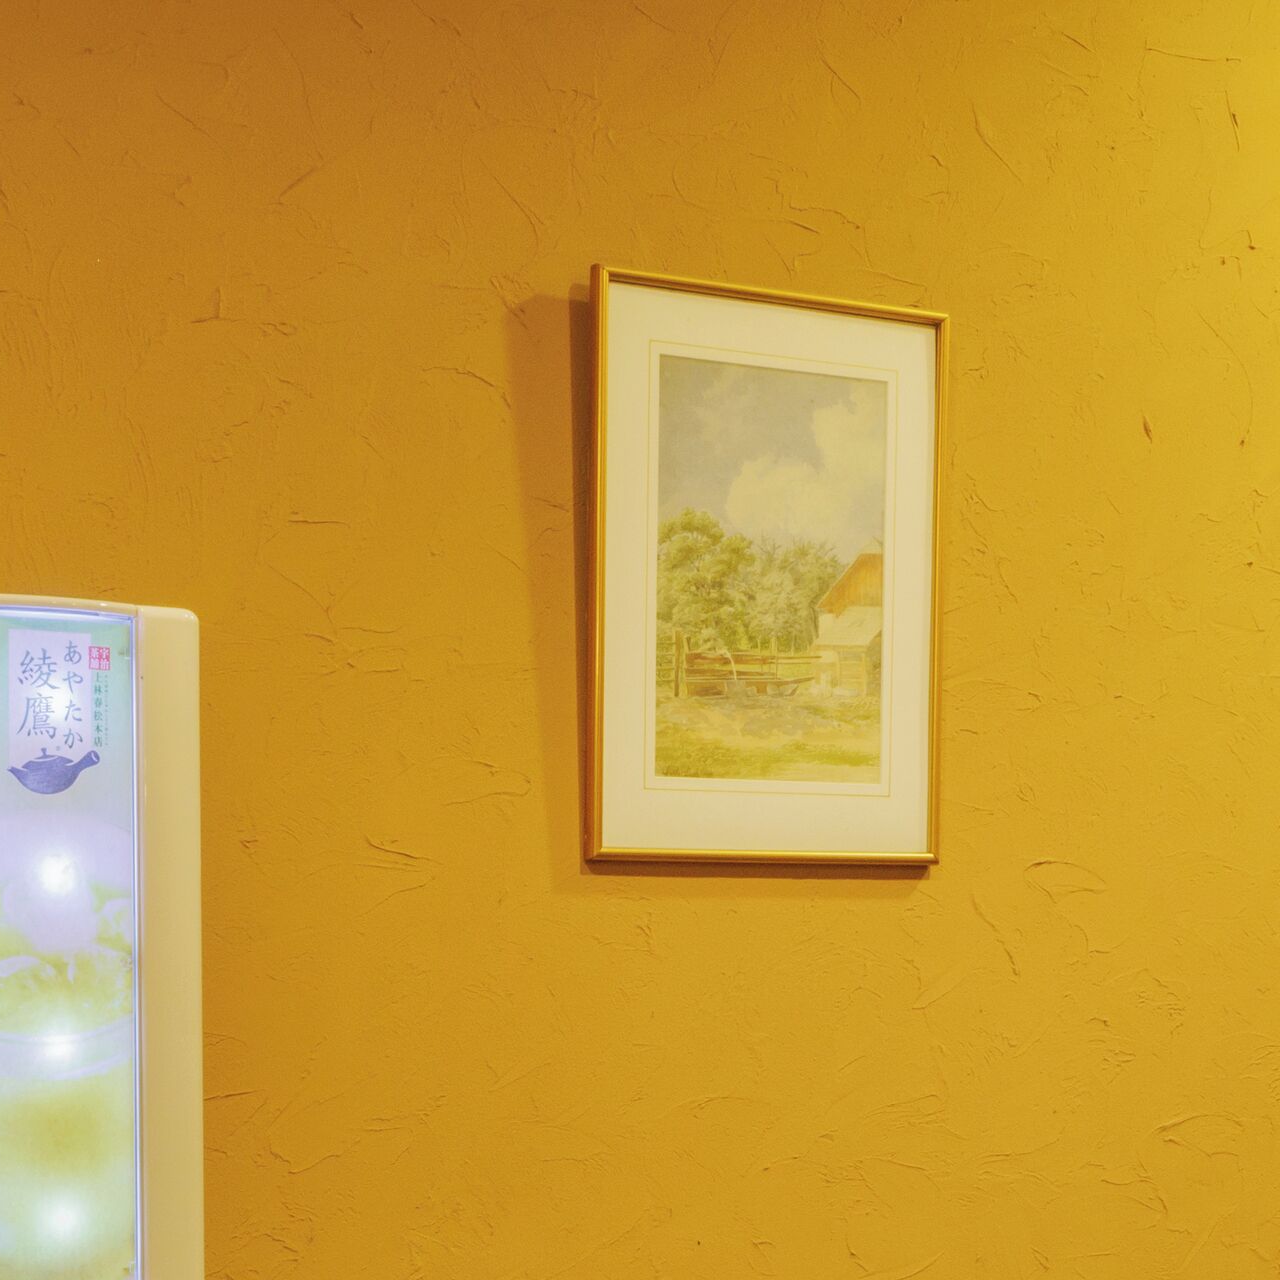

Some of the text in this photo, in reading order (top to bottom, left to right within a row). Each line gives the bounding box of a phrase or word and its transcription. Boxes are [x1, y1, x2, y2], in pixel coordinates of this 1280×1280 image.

[17, 648, 60, 740] 綾鷹
[63, 640, 84, 749] あやたか
